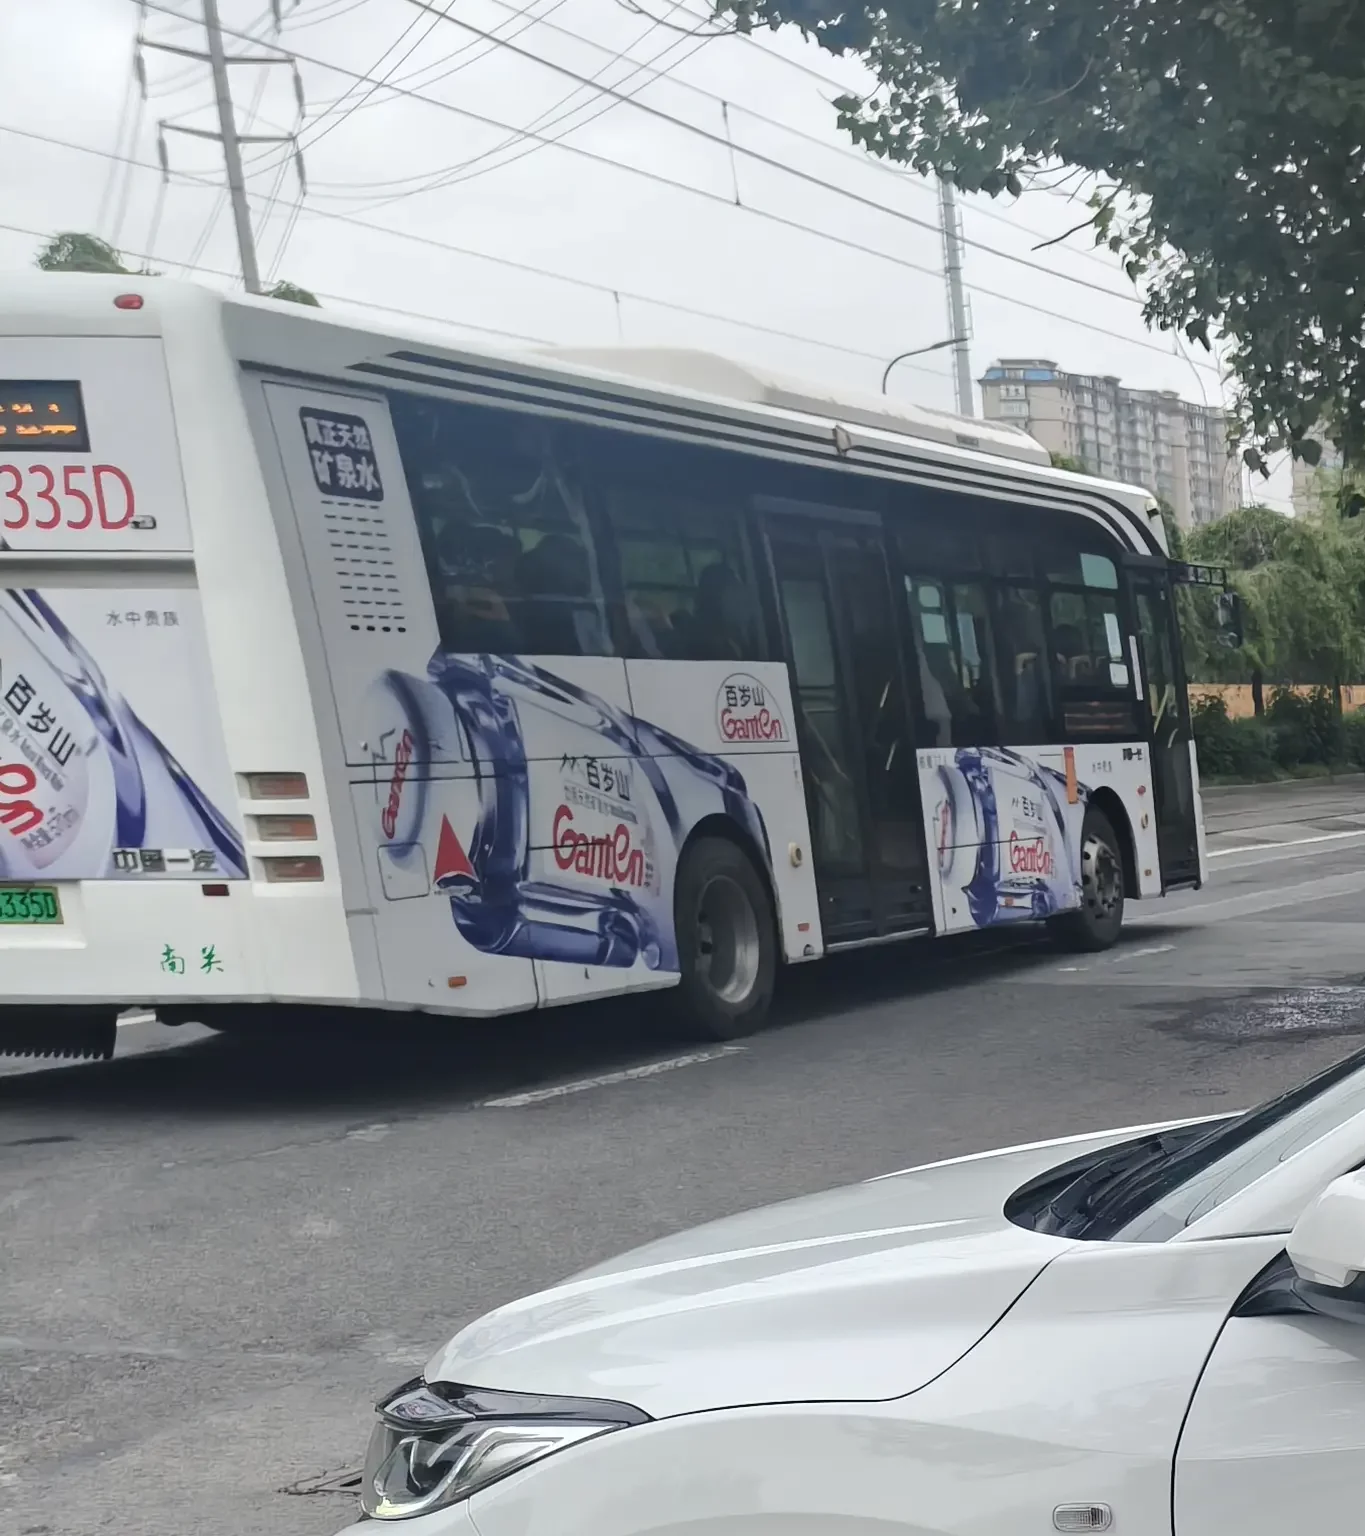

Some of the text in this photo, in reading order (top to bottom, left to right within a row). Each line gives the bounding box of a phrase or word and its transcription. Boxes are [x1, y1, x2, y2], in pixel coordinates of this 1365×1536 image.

[0, 464, 135, 530] 335D
[5, 674, 76, 766] 百岁山
[725, 685, 765, 707] 百岁山
